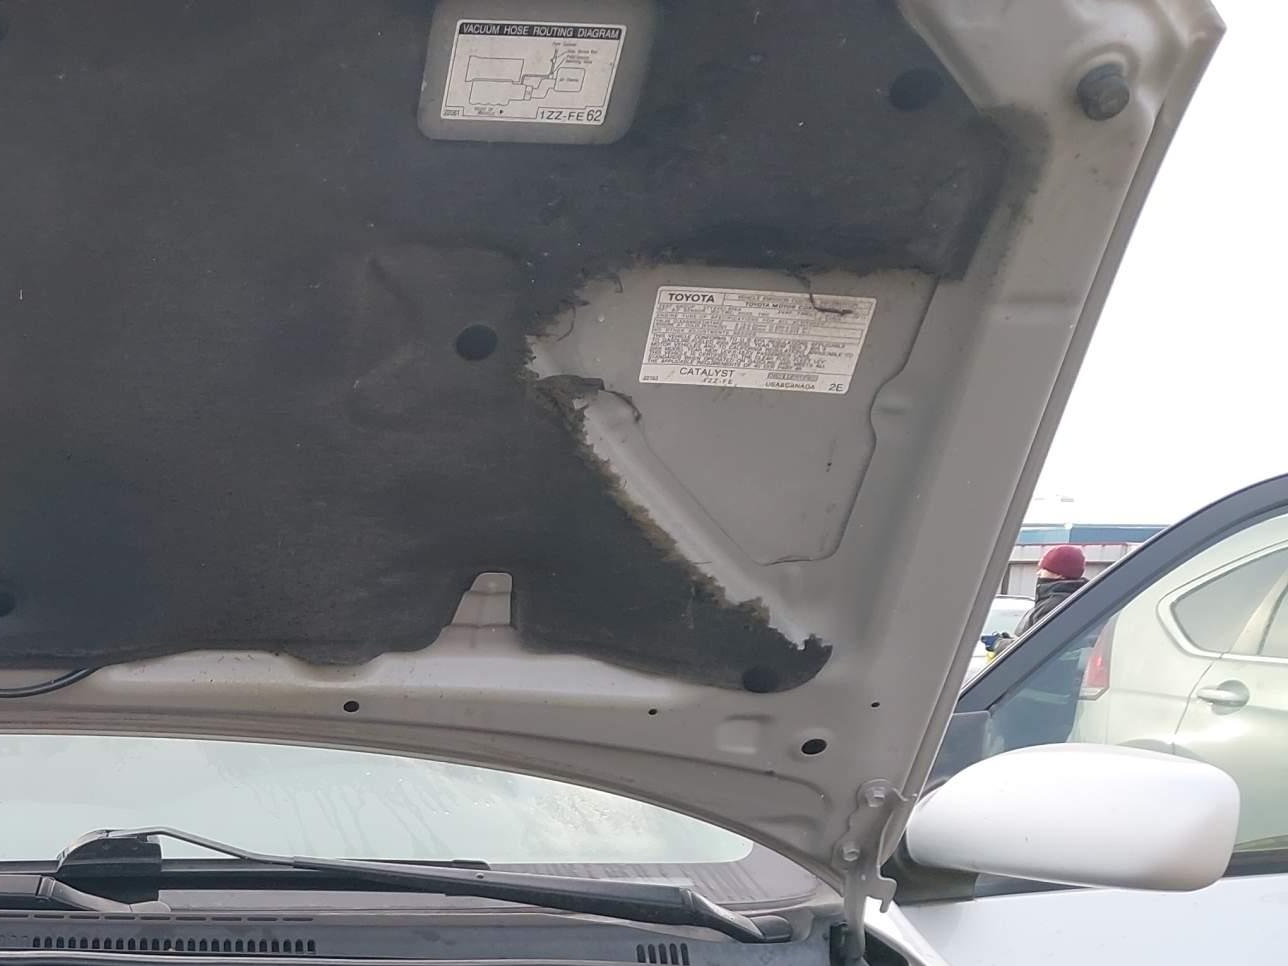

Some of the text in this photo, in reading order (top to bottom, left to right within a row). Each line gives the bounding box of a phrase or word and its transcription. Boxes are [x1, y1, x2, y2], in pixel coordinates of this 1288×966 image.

[462, 24, 620, 39] VACUUM HOSE ROUTING DIAGRAM
[539, 109, 602, 122] 1ZZ-FE 62
[668, 293, 715, 304] TOYOTA
[679, 367, 736, 377] CATALYST
[828, 383, 844, 392] 2E
